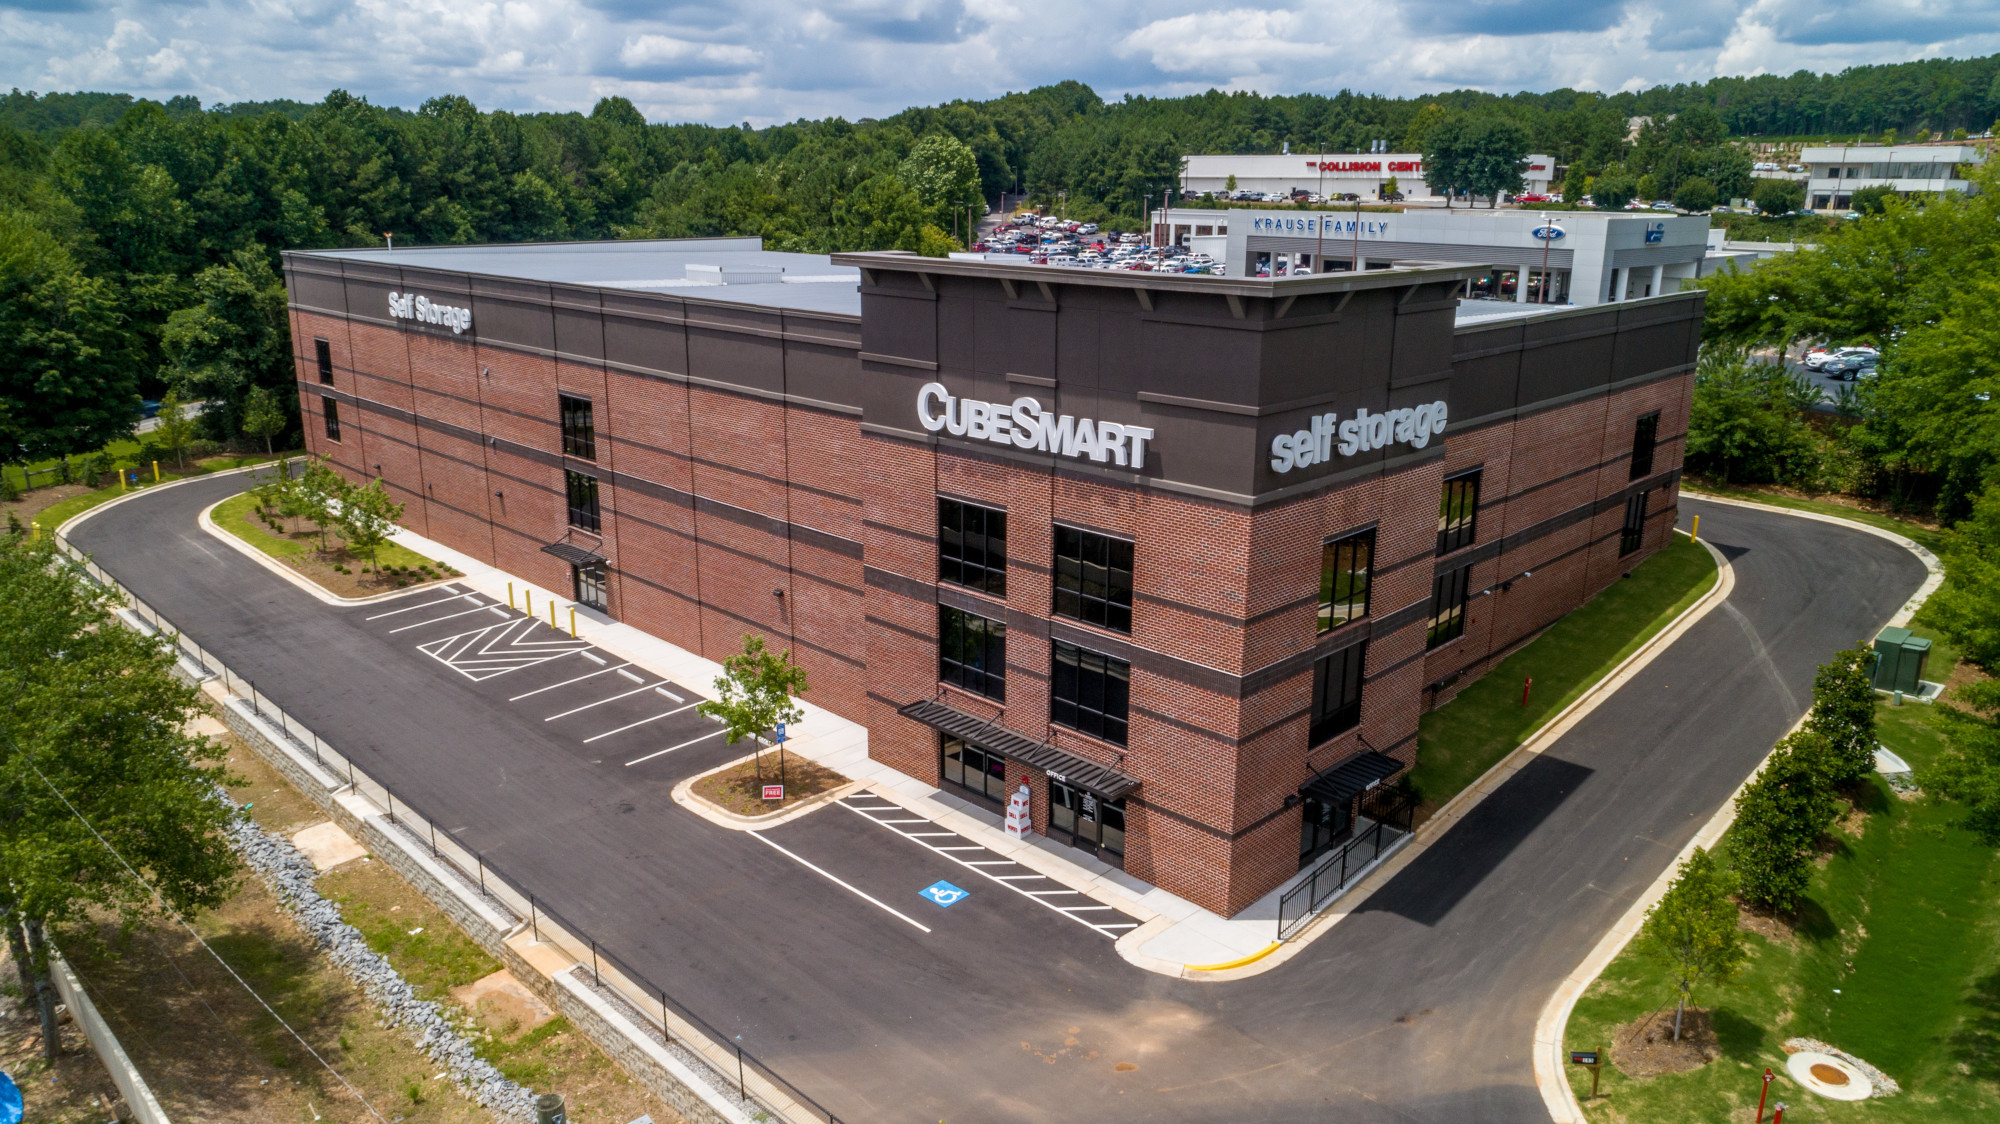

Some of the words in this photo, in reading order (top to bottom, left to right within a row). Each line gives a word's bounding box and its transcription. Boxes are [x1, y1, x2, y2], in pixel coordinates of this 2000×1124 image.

[1319, 162, 1380, 172] COLLISION
[1388, 162, 1428, 172] CENT
[1254, 218, 1315, 231] KRAUSE
[1324, 220, 1388, 233] FAMILY
[388, 291, 415, 319] Self
[415, 295, 472, 334] Storage
[1271, 412, 1337, 474] self
[1337, 400, 1448, 457] storage
[1046, 769, 1066, 782] OFFICE
